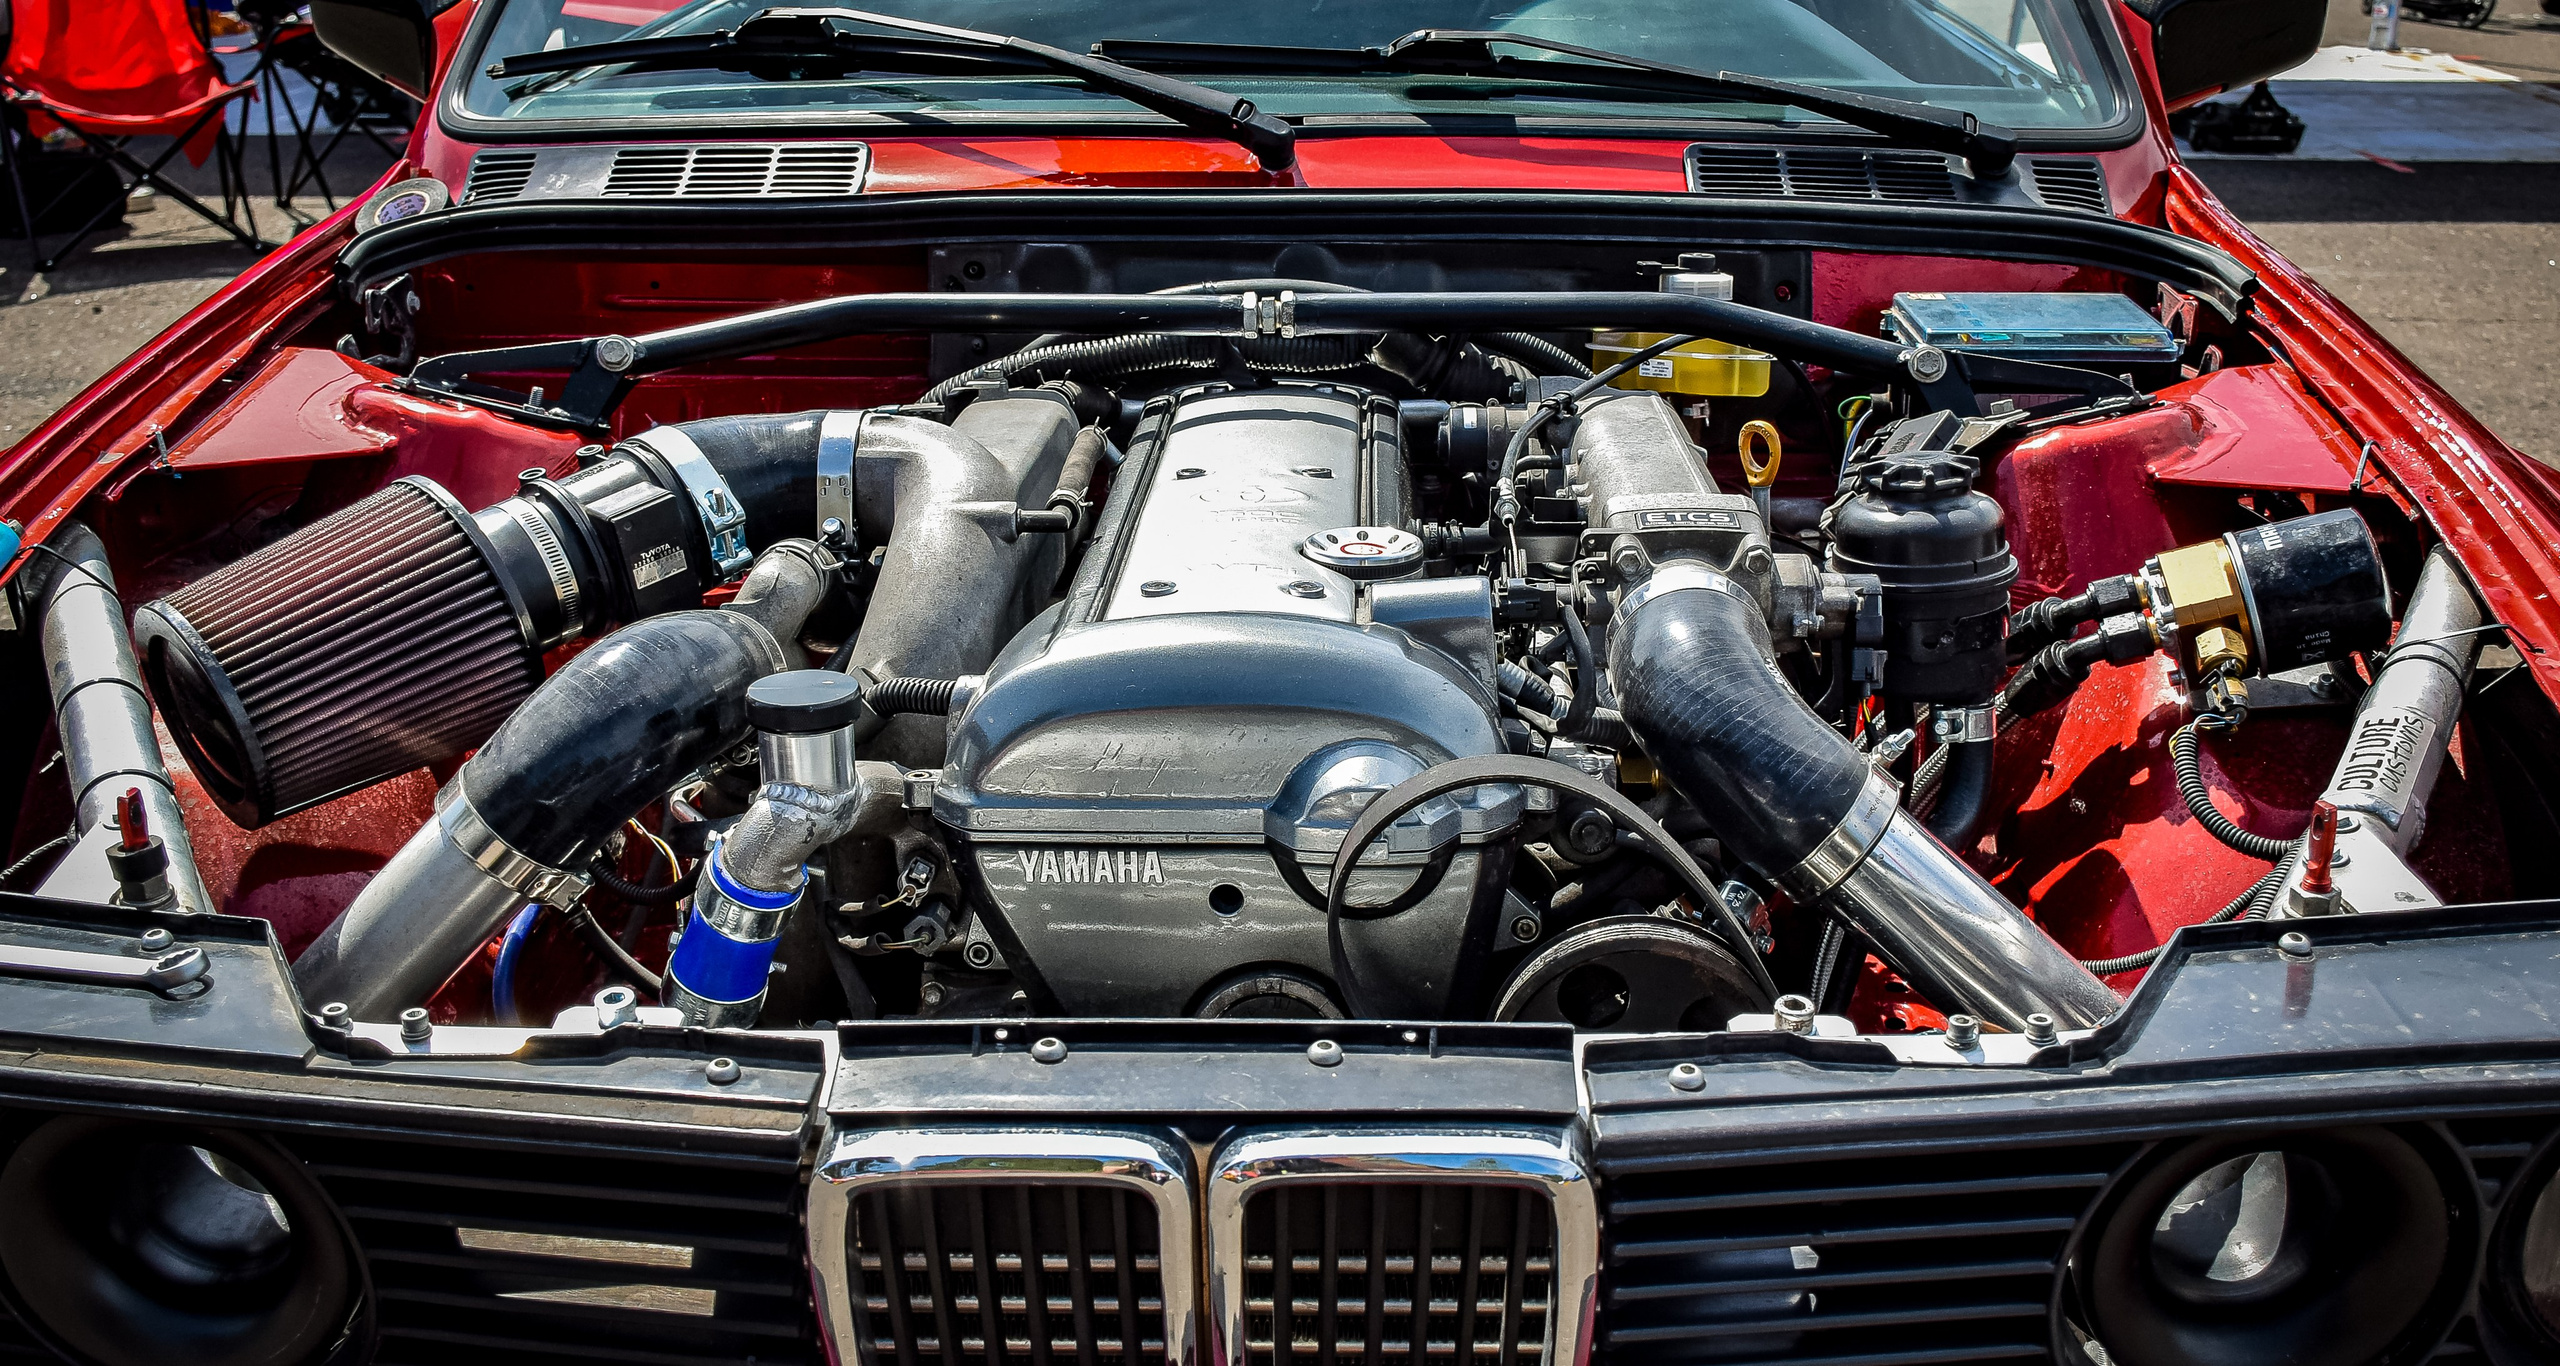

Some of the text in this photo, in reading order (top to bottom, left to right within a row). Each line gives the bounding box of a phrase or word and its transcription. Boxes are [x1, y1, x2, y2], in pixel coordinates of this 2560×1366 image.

[1646, 512, 1730, 522] ETCS
[2305, 630, 2330, 640] China
[2311, 638, 2331, 646] Made
[2337, 718, 2400, 791] CULTURE
[1018, 850, 1165, 883] YAMAHA
